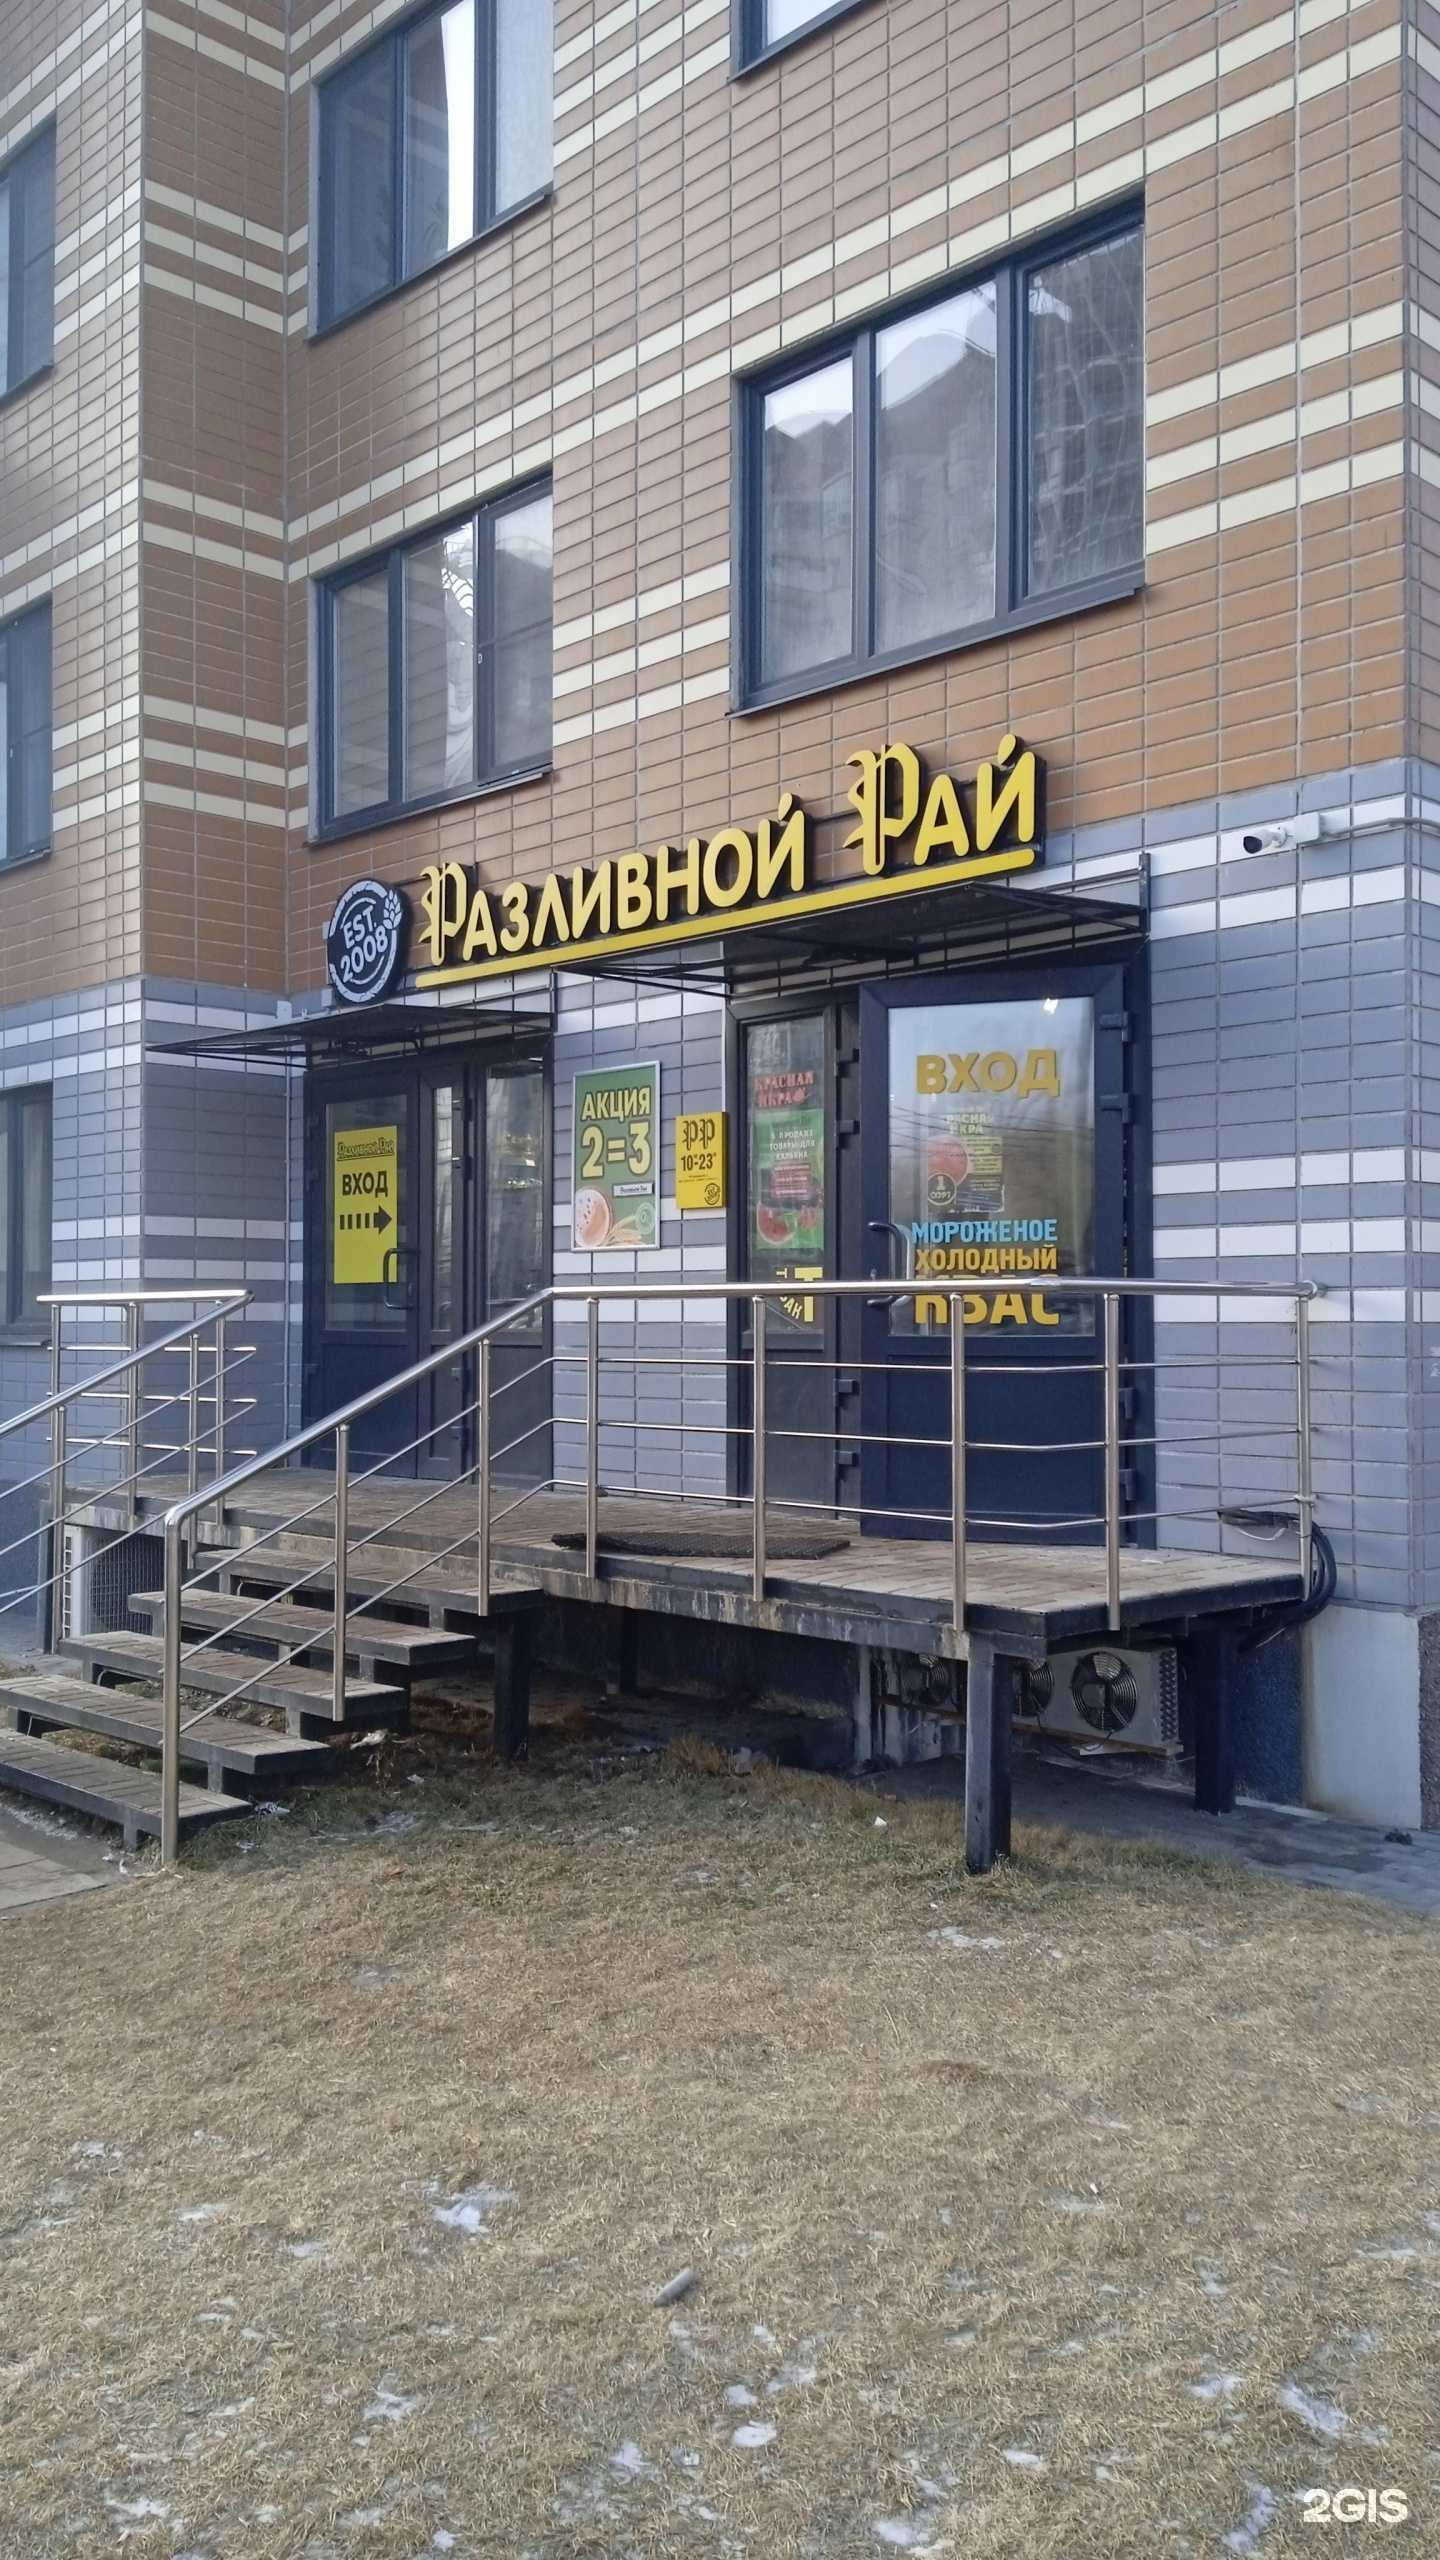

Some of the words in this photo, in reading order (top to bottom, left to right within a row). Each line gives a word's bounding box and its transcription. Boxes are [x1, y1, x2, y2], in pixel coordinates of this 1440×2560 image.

[341, 925, 388, 983] 2008
[916, 1048, 1061, 1098] ВХОД
[581, 1086, 652, 1123] АКЦИЯ
[581, 1121, 653, 1179] 2=3
[342, 1170, 389, 1198] ВХОД
[911, 1218, 1058, 1244] МОРОЖЕНОЕ
[915, 1244, 1058, 1274] ХОЛОДНЫЙ
